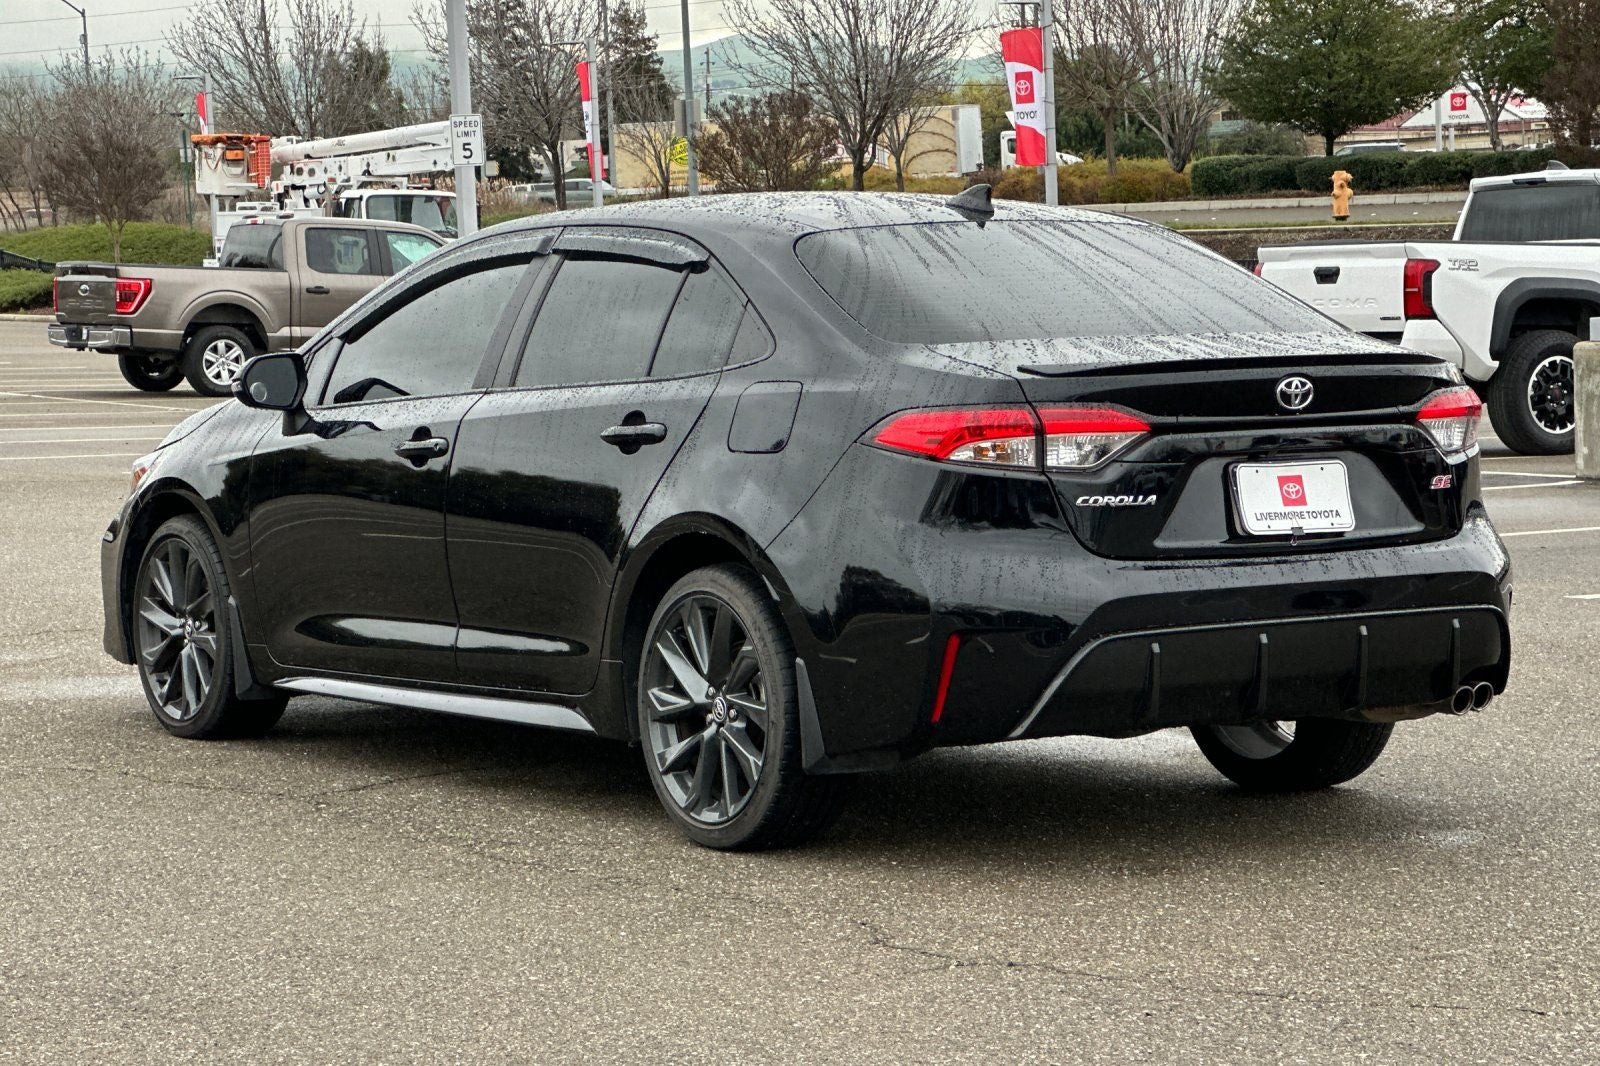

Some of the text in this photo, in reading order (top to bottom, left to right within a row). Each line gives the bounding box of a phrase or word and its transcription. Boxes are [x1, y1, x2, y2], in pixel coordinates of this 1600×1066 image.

[453, 120, 479, 128] SPEED
[456, 130, 477, 138] LIMIT
[462, 142, 473, 159] 5
[1448, 258, 1479, 267] TRD
[1312, 298, 1378, 308] COMA
[1430, 475, 1452, 489] SE
[1076, 494, 1157, 507] COROLLA
[1254, 509, 1342, 521] LIVERMORE TOYOTA
